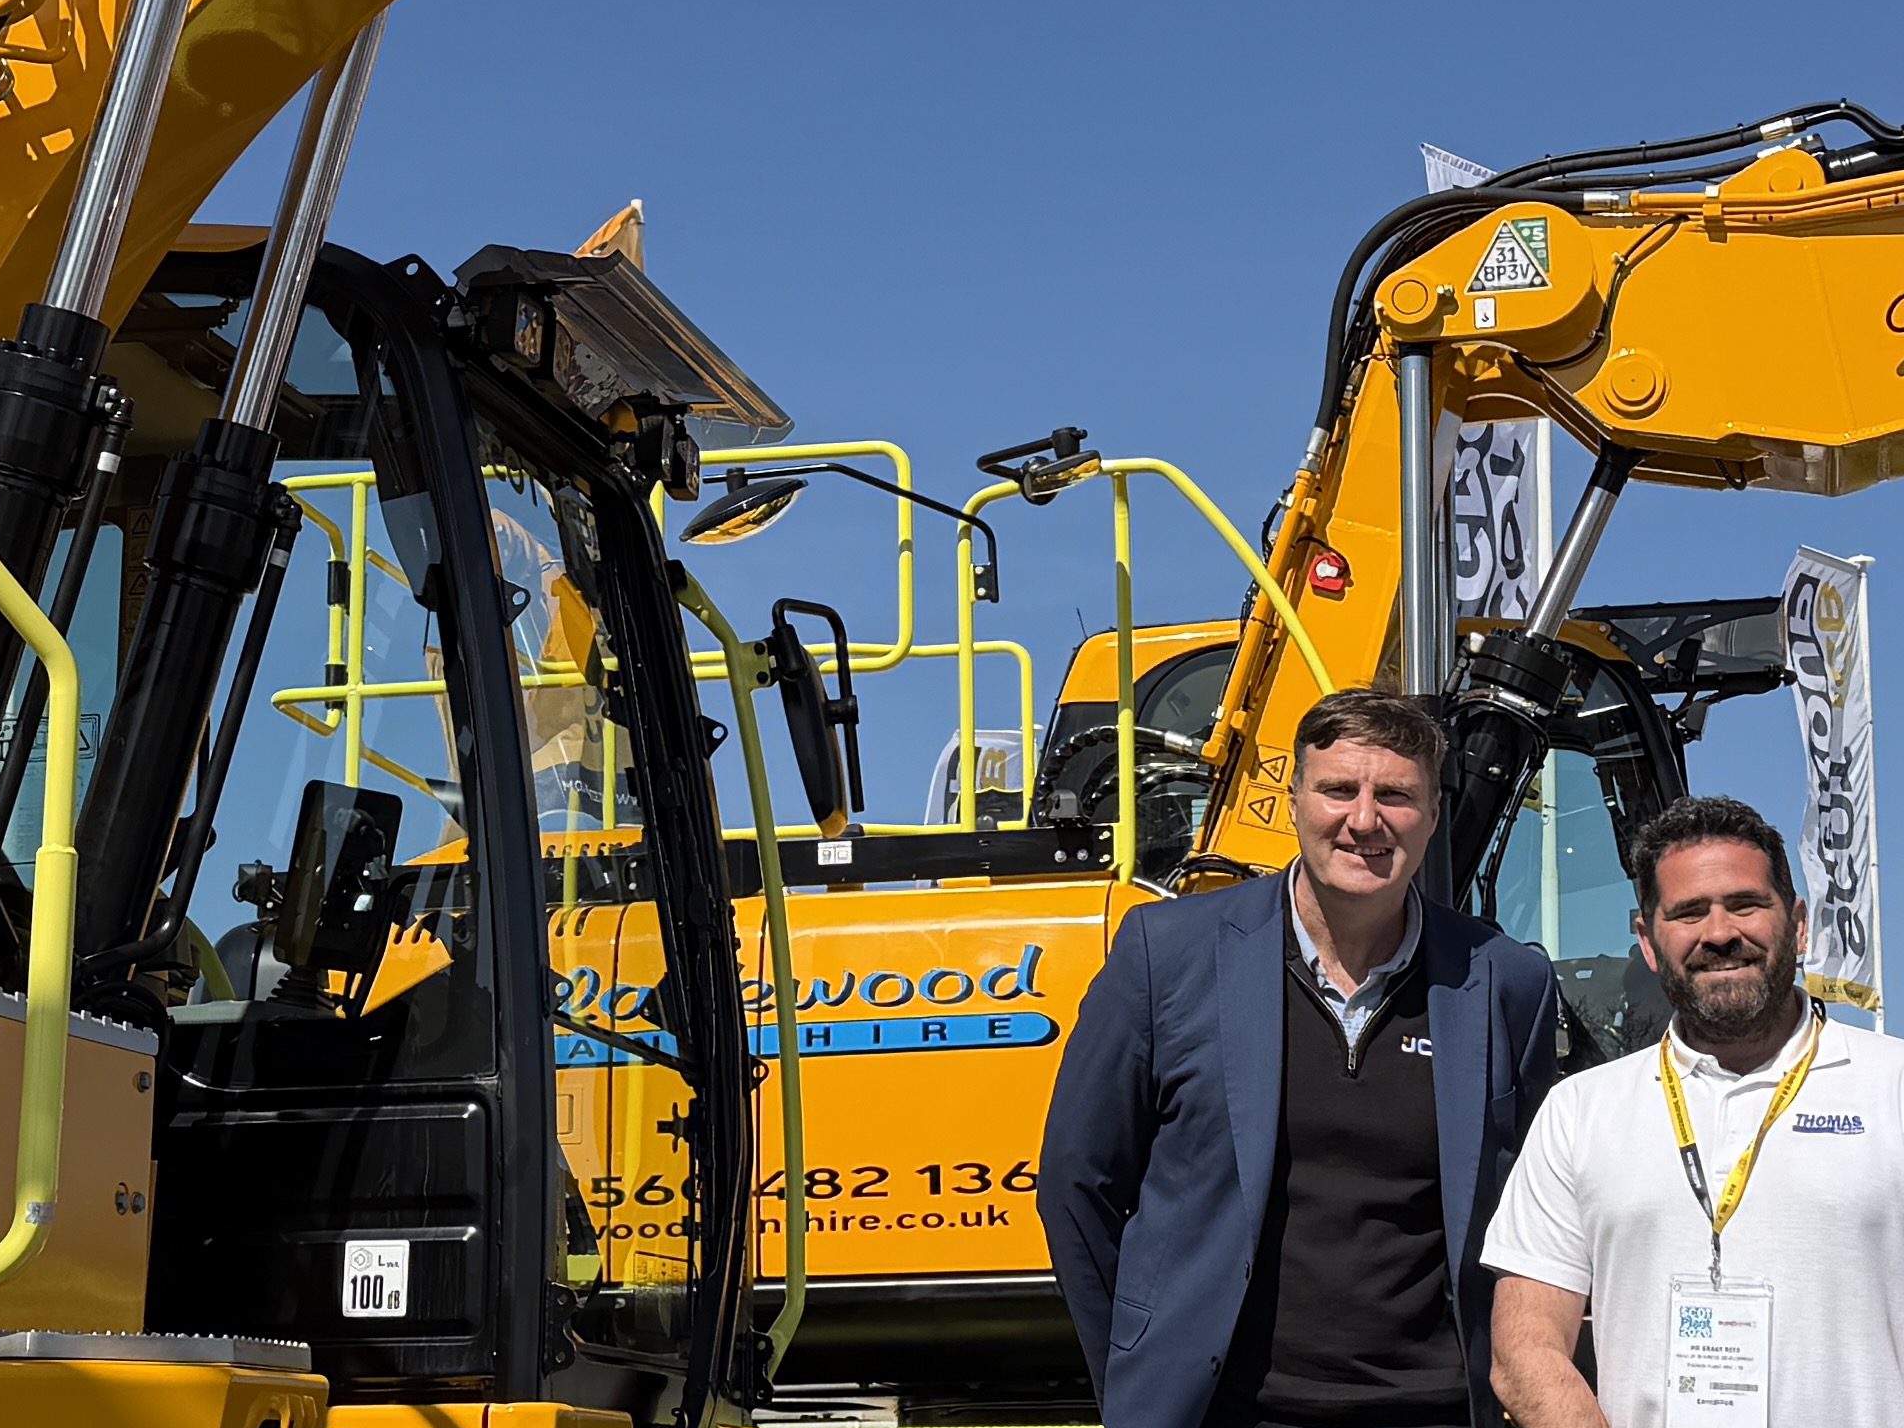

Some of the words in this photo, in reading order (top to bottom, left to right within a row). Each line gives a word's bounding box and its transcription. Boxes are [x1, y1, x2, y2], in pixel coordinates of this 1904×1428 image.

[1496, 246, 1517, 264] 31
[805, 1017, 1013, 1048] HIRE
[1401, 1036, 1433, 1056] JC
[1795, 1113, 1863, 1131] THOMAS
[350, 1274, 384, 1309] 100
